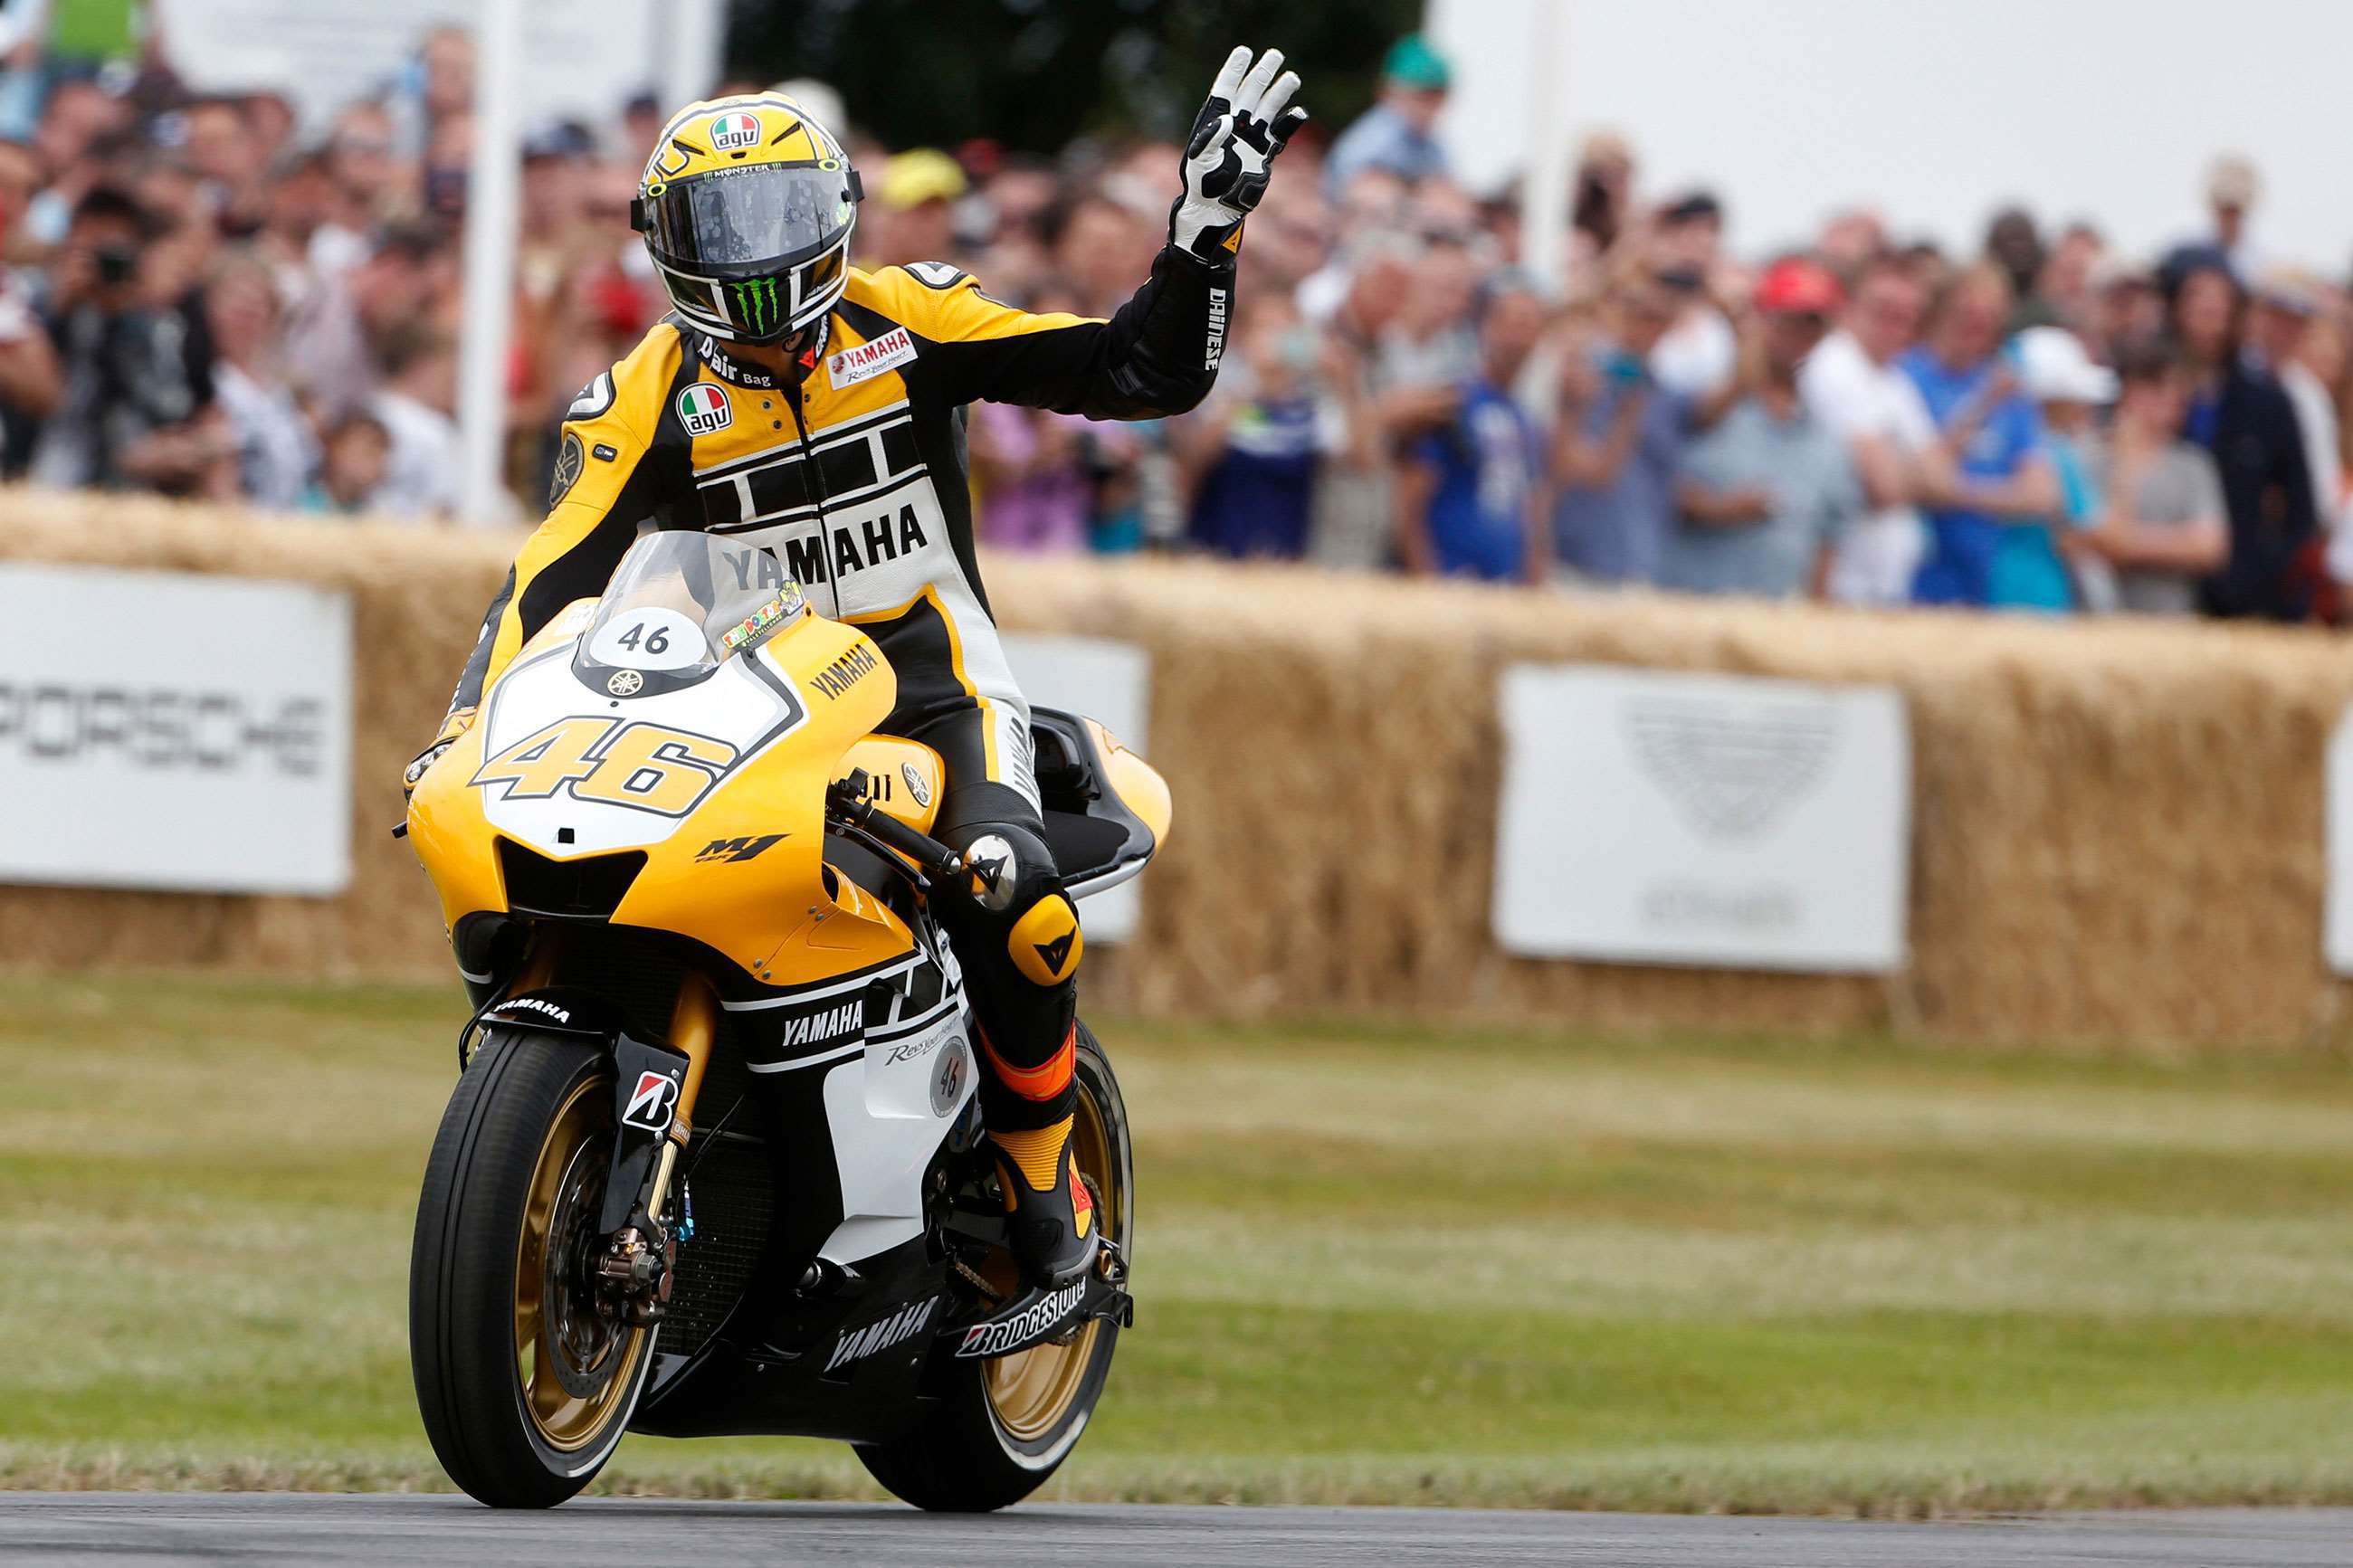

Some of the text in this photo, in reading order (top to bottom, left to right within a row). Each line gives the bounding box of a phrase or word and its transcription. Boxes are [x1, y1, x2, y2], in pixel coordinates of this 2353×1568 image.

[719, 129, 754, 147] agv
[714, 164, 769, 178] MONSTER
[845, 331, 910, 367] YAMAHA
[742, 373, 772, 387] Bag
[691, 413, 728, 434] agv
[720, 504, 929, 591] YAMAHA
[618, 622, 669, 655] 46
[810, 643, 878, 699] YAMAHA
[467, 716, 740, 818] 46
[493, 998, 570, 1023] YAMAHA
[782, 1001, 863, 1047] YAMAHA
[940, 1057, 959, 1098] 46
[824, 1295, 939, 1373] YAMAHA
[955, 1276, 1087, 1357] BRIDGESTONE
